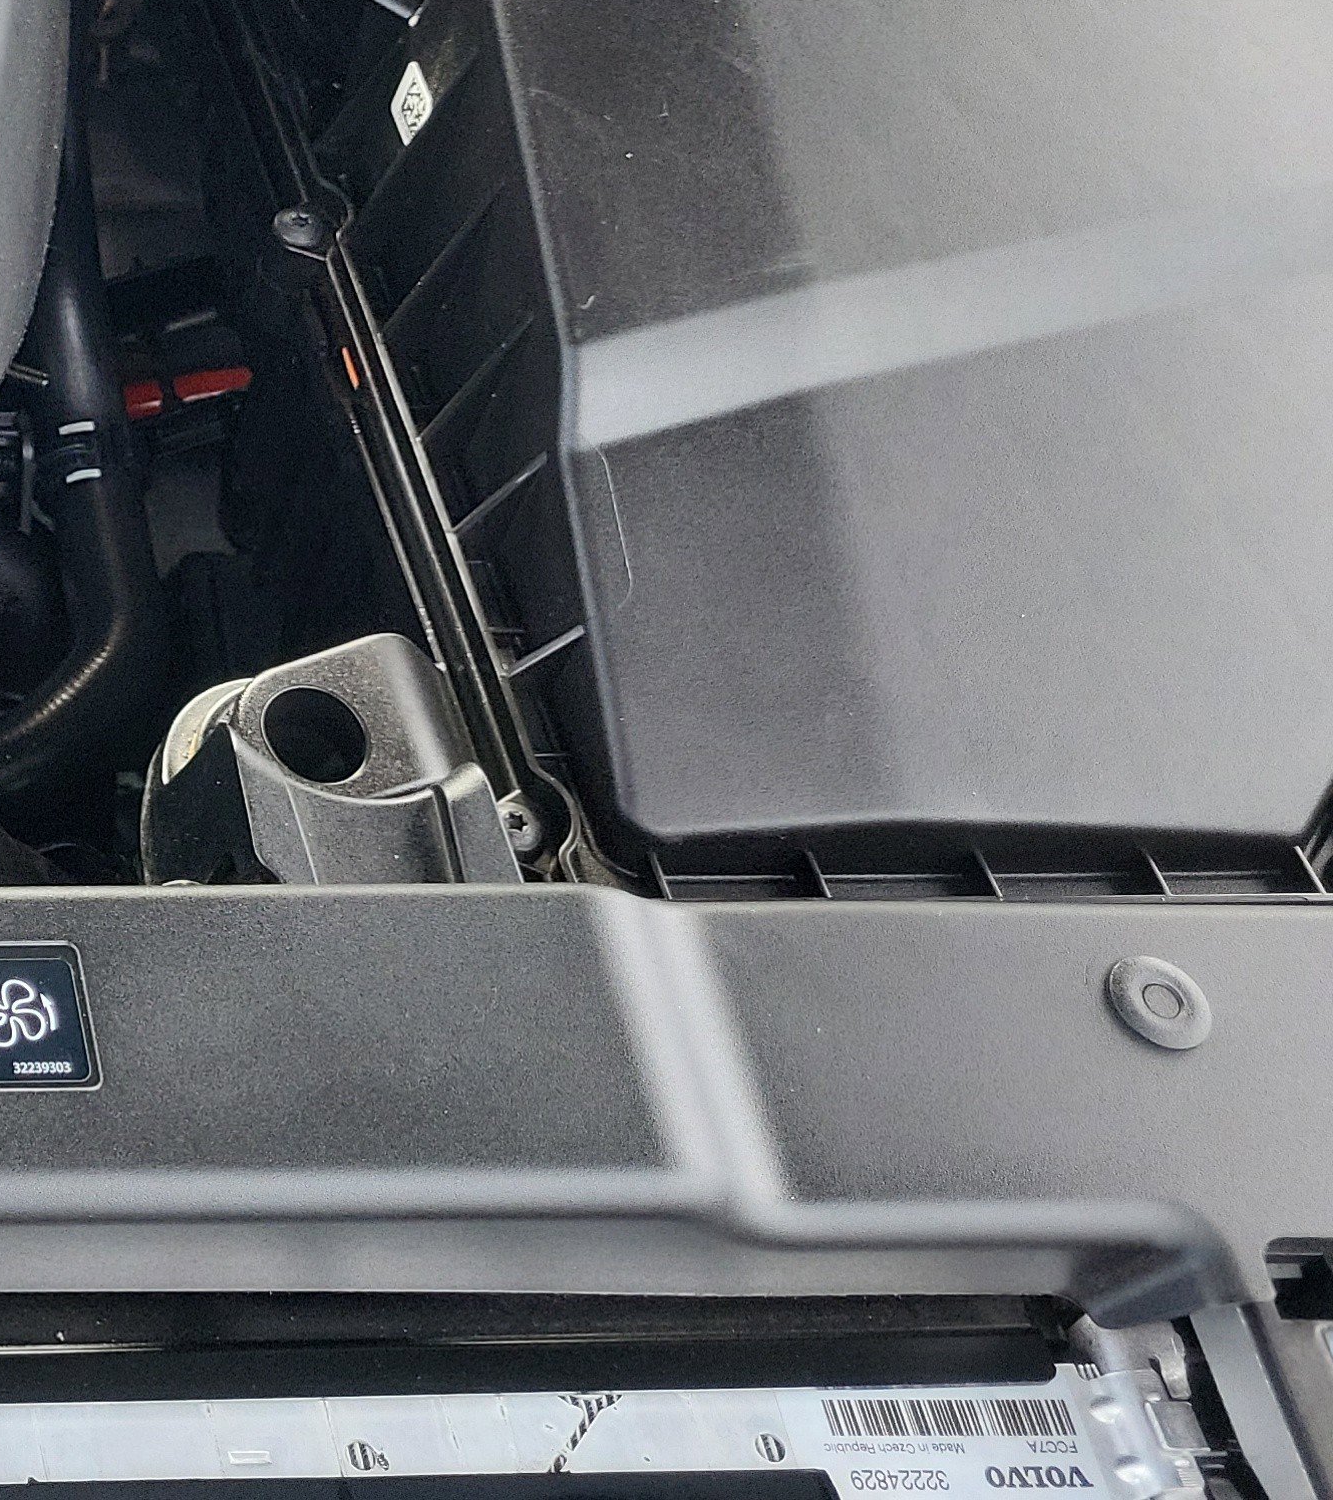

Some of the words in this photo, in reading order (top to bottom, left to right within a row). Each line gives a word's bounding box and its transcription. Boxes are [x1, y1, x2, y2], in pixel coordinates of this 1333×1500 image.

[13, 1061, 73, 1075] 32239303
[823, 1440, 876, 1455] Republic
[878, 1442, 916, 1454] Czech
[918, 1442, 929, 1454] in
[932, 1442, 965, 1454] Made
[1026, 1440, 1079, 1455] FCC7A
[849, 1468, 950, 1491] 32224829
[984, 1466, 1094, 1489] VOLVO
